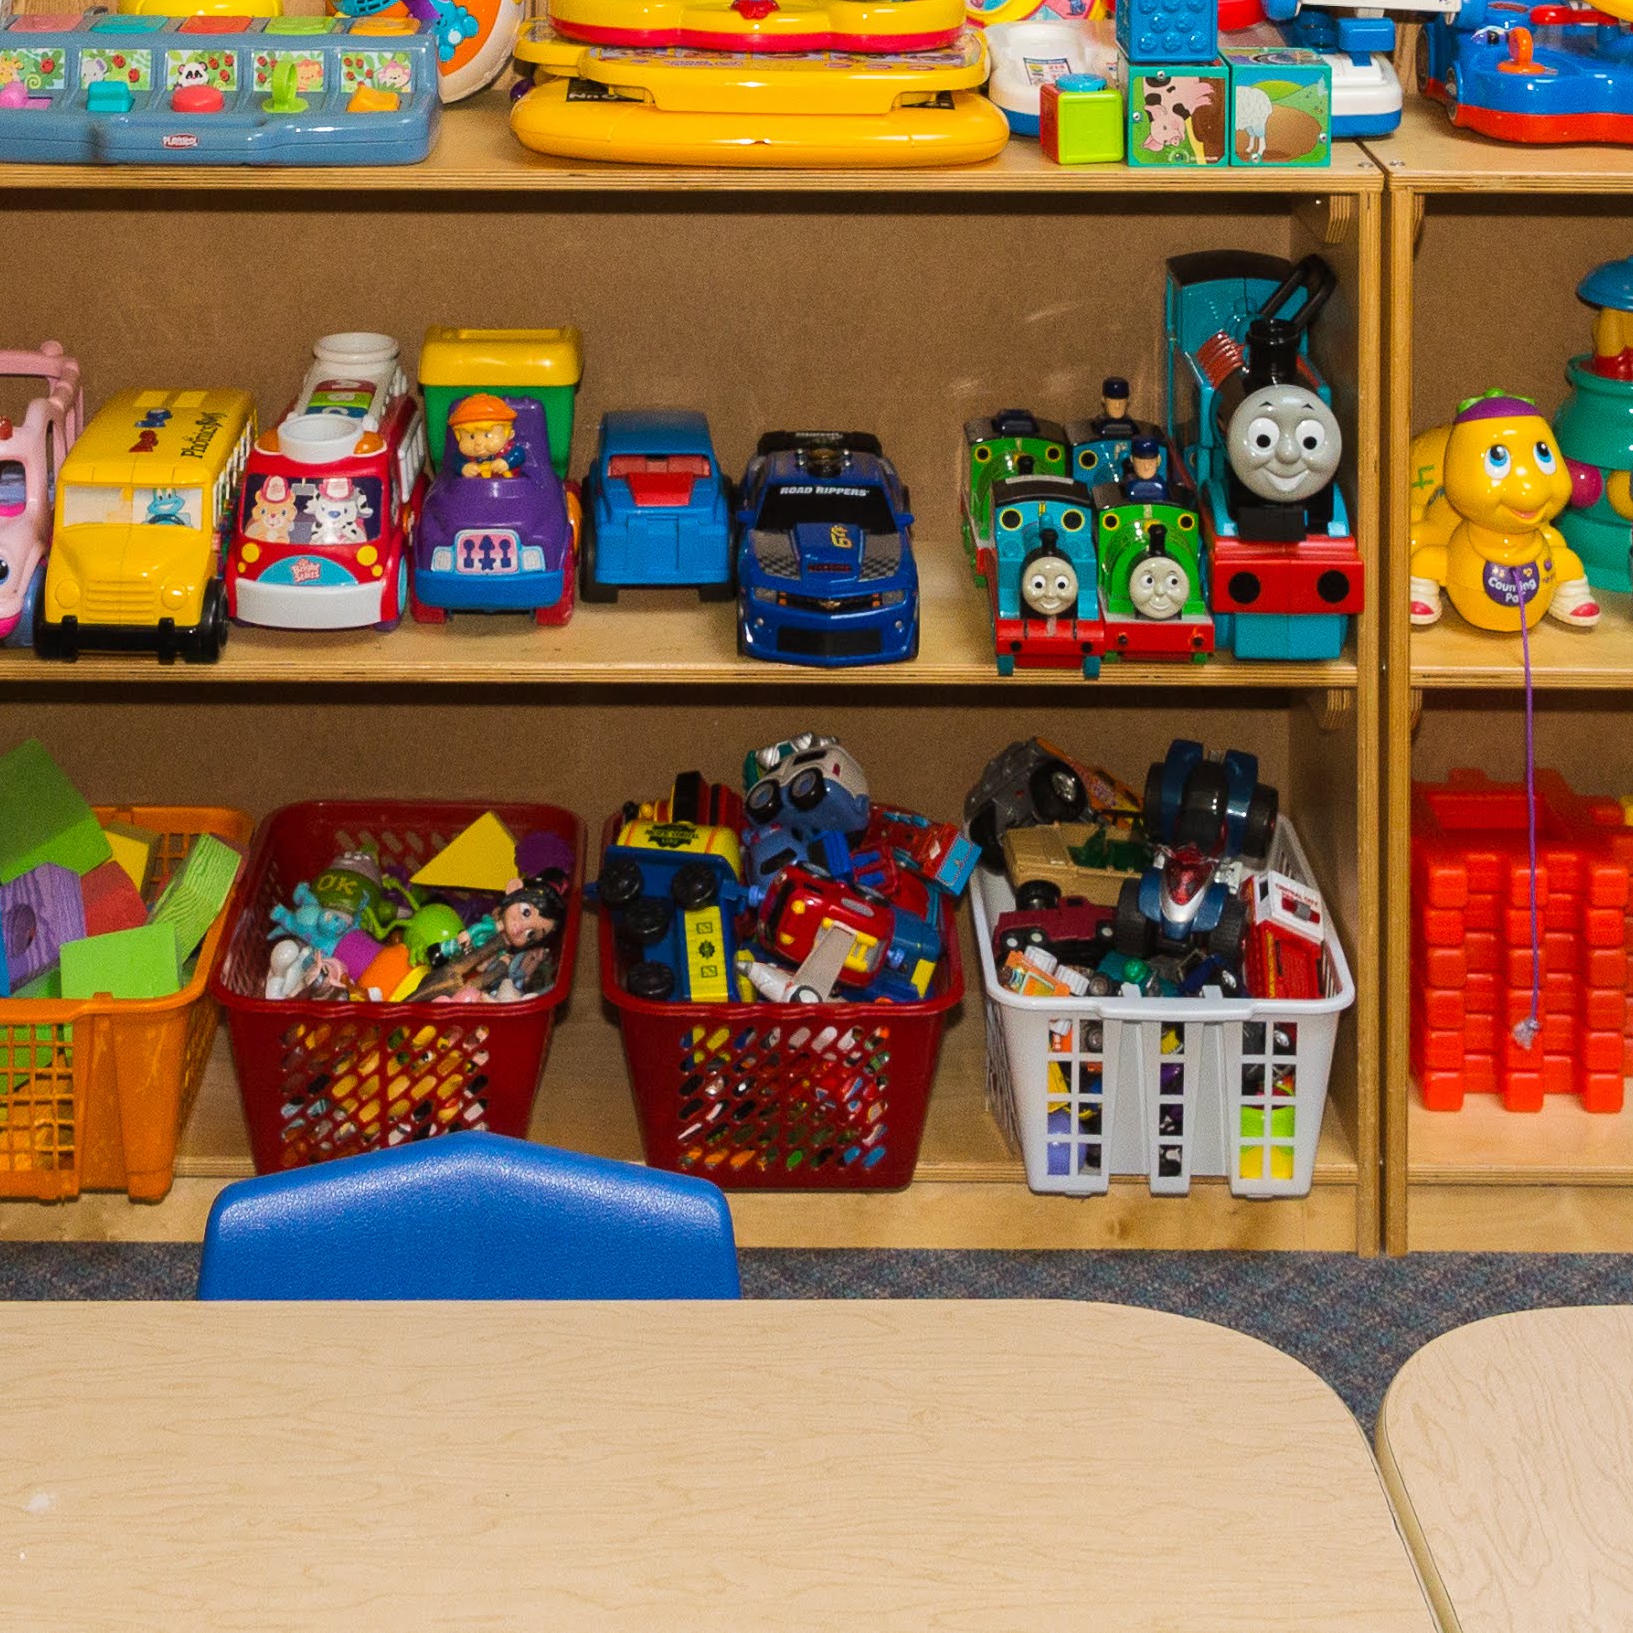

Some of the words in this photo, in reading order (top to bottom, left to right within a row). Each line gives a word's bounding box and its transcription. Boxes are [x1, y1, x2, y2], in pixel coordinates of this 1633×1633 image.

[780, 486, 813, 495] ROAD
[815, 486, 867, 497] RIPPERS
[1488, 576, 1537, 593] Couning
[318, 874, 358, 895] OK
